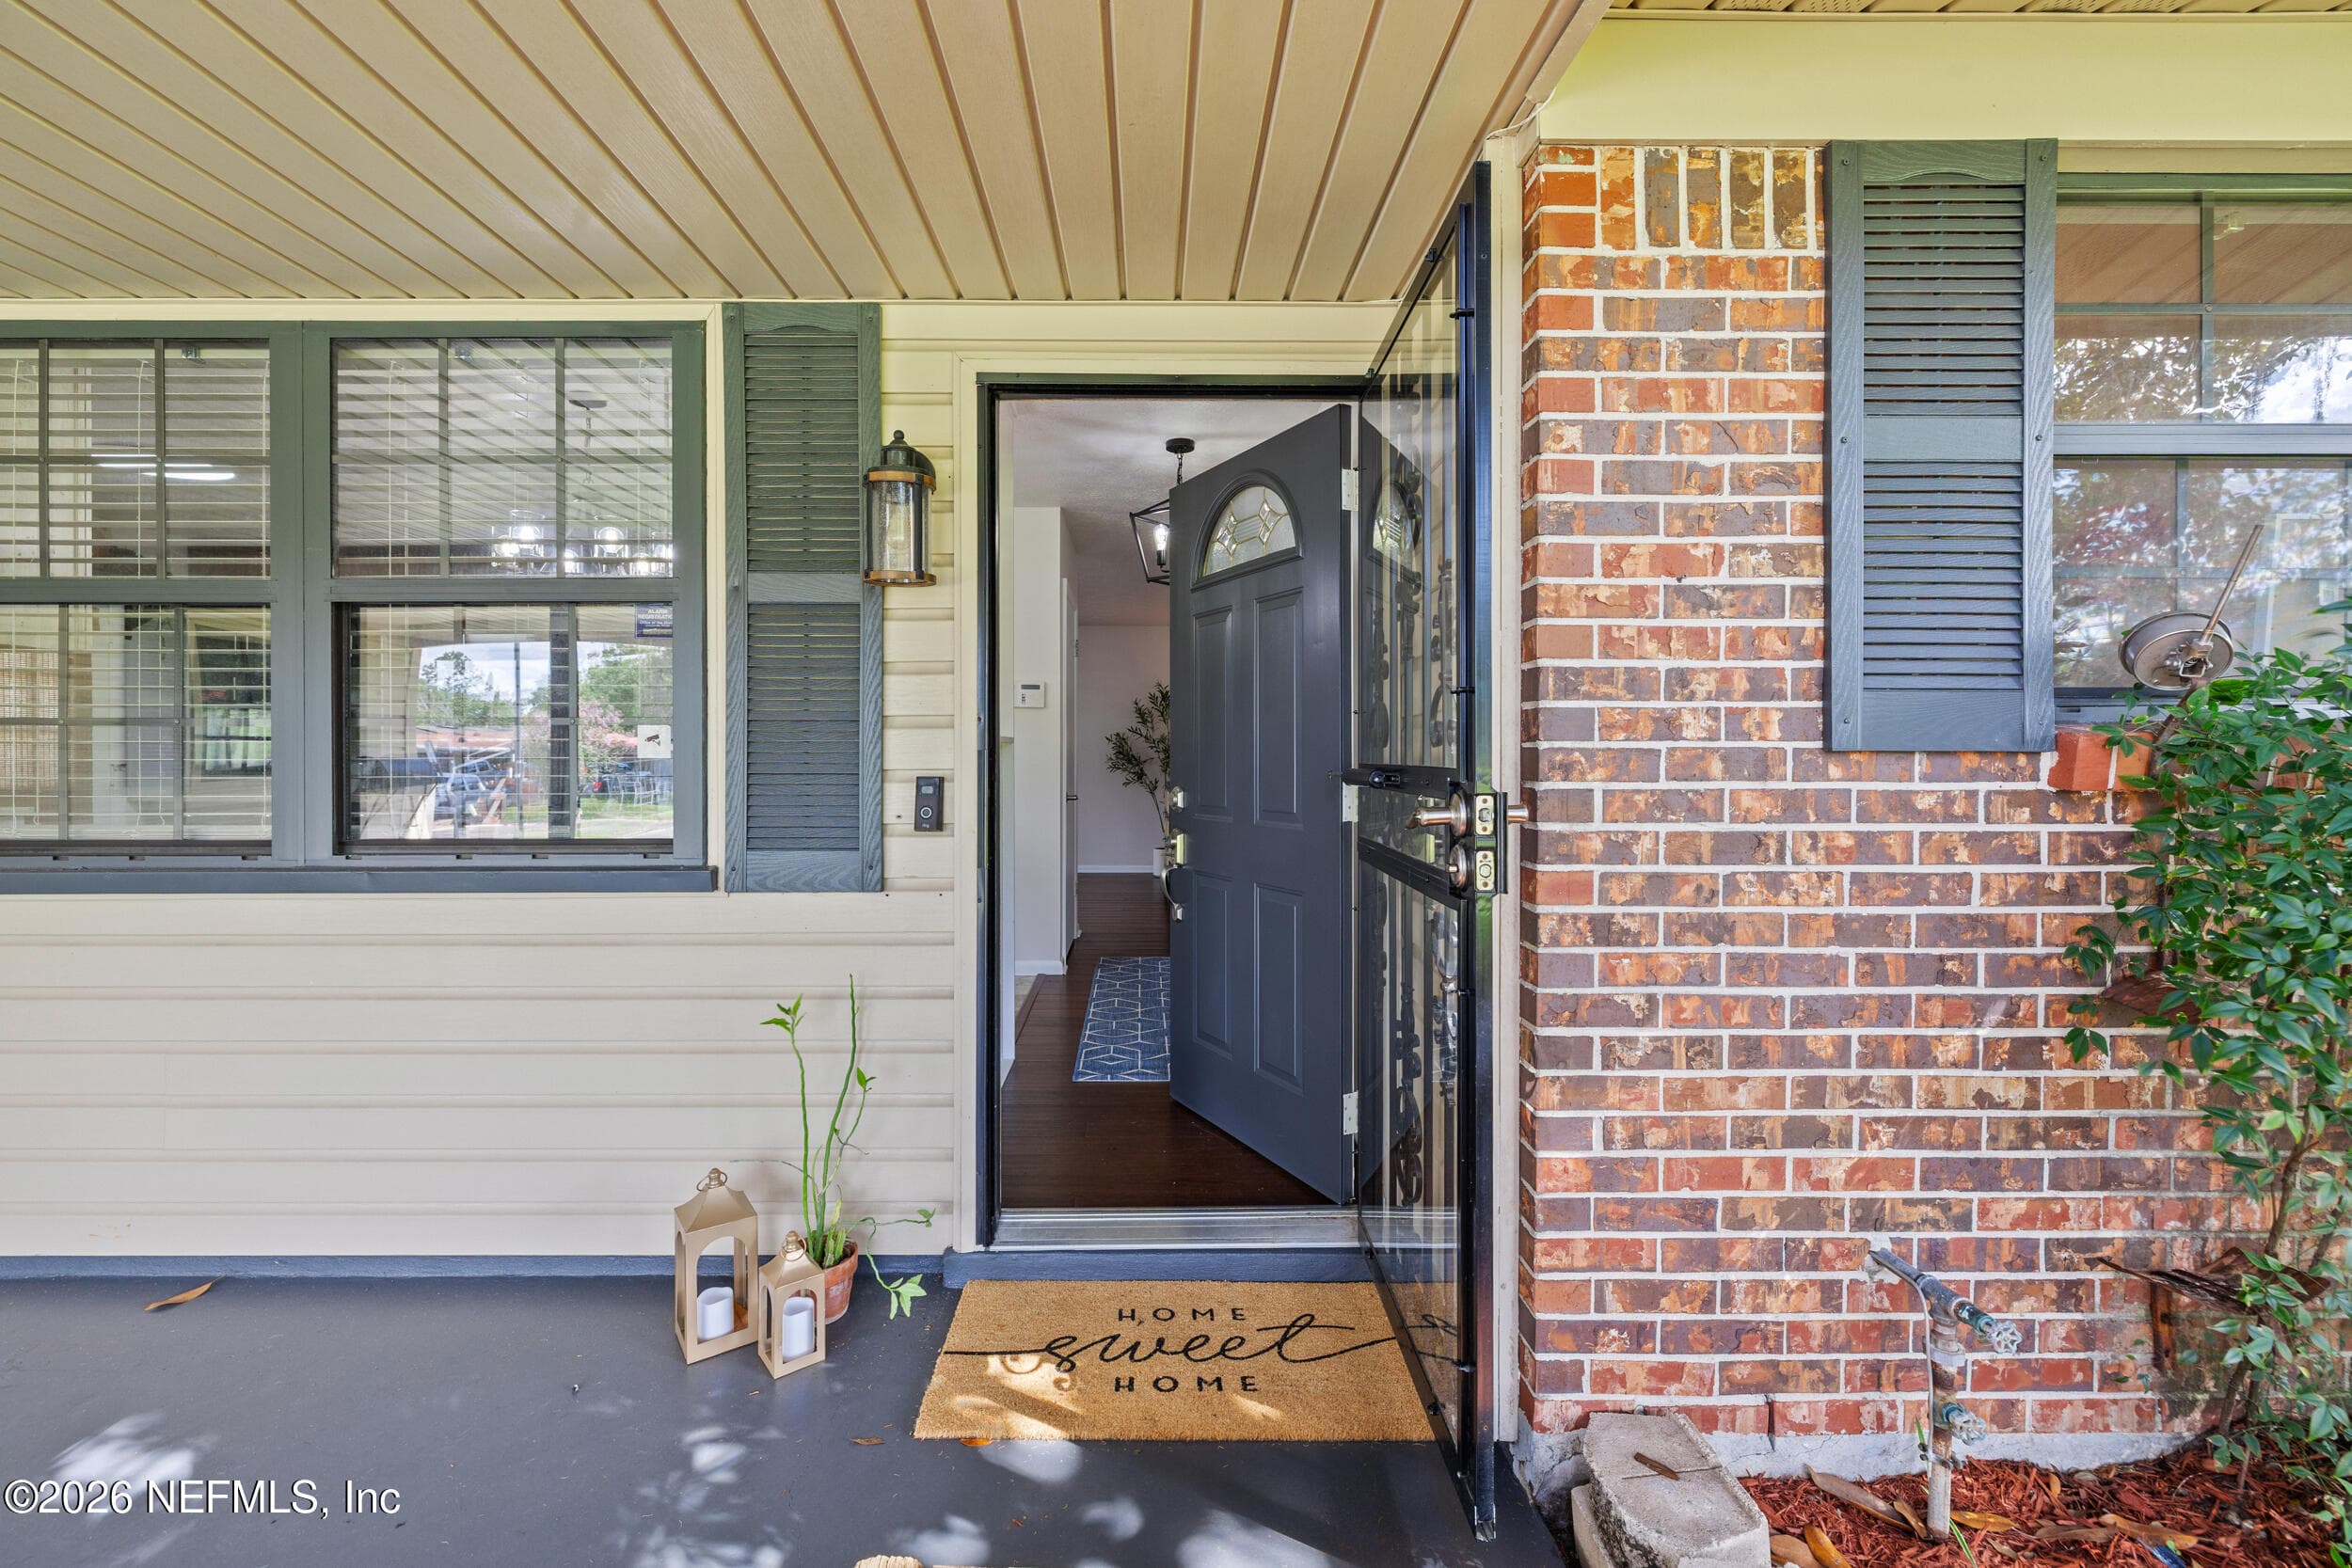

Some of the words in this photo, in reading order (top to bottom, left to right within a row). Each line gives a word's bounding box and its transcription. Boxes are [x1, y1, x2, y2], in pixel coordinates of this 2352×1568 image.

[1117, 1307, 1247, 1323] HOME
[944, 1313, 1397, 1373] sweet
[1113, 1374, 1259, 1394] HOME
